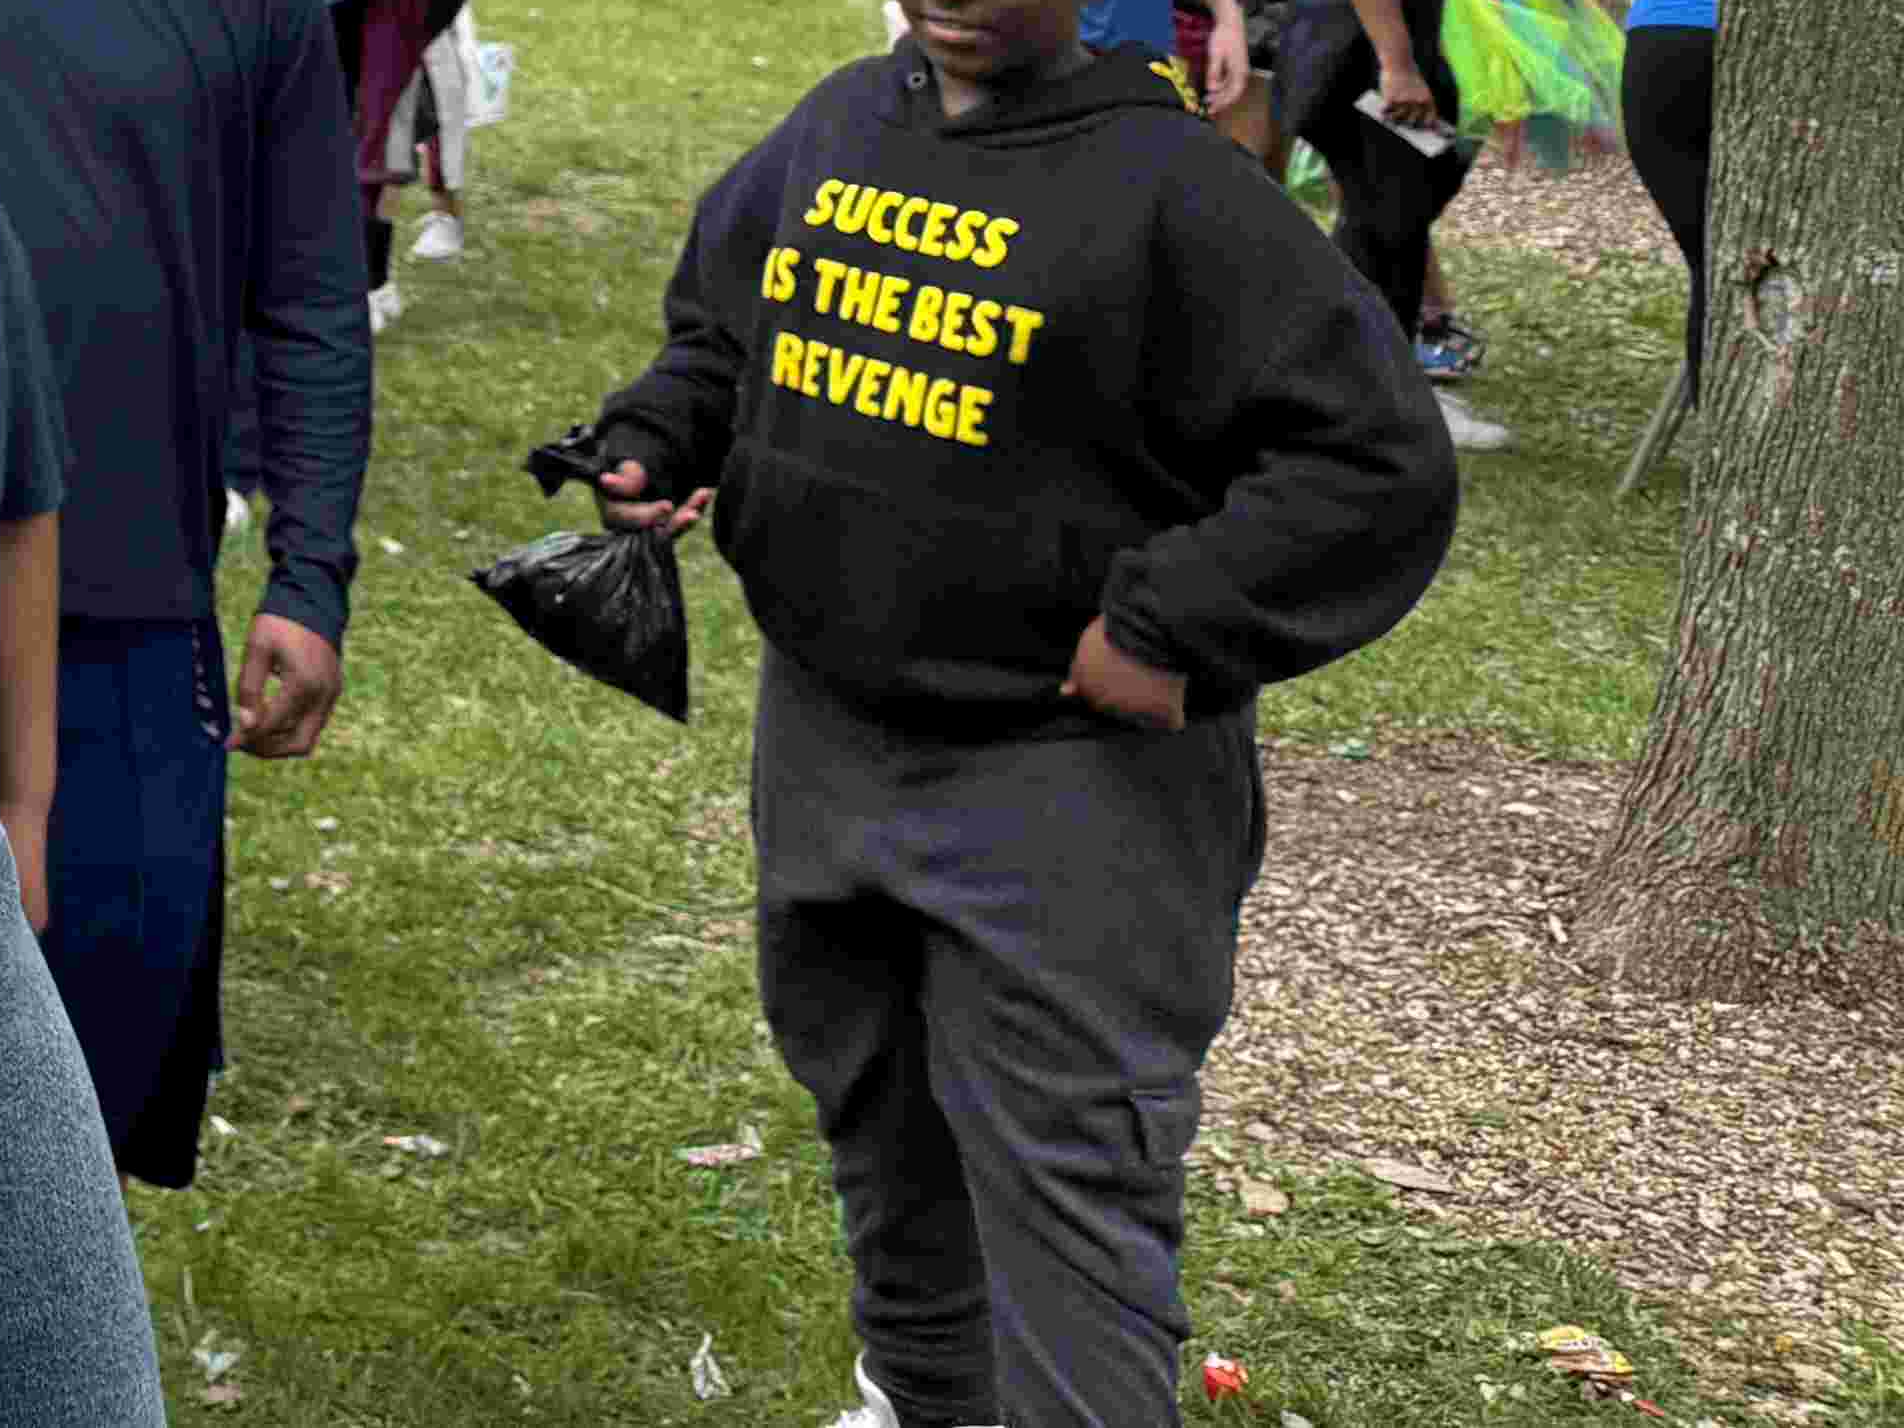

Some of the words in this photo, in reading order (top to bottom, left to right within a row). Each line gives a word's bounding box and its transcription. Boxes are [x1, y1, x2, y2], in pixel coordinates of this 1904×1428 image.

[804, 179, 1019, 267] SUCCESS
[762, 248, 800, 301] IS
[815, 258, 910, 332] THE
[909, 286, 1043, 365] BEST
[772, 332, 992, 444] REVENGE
